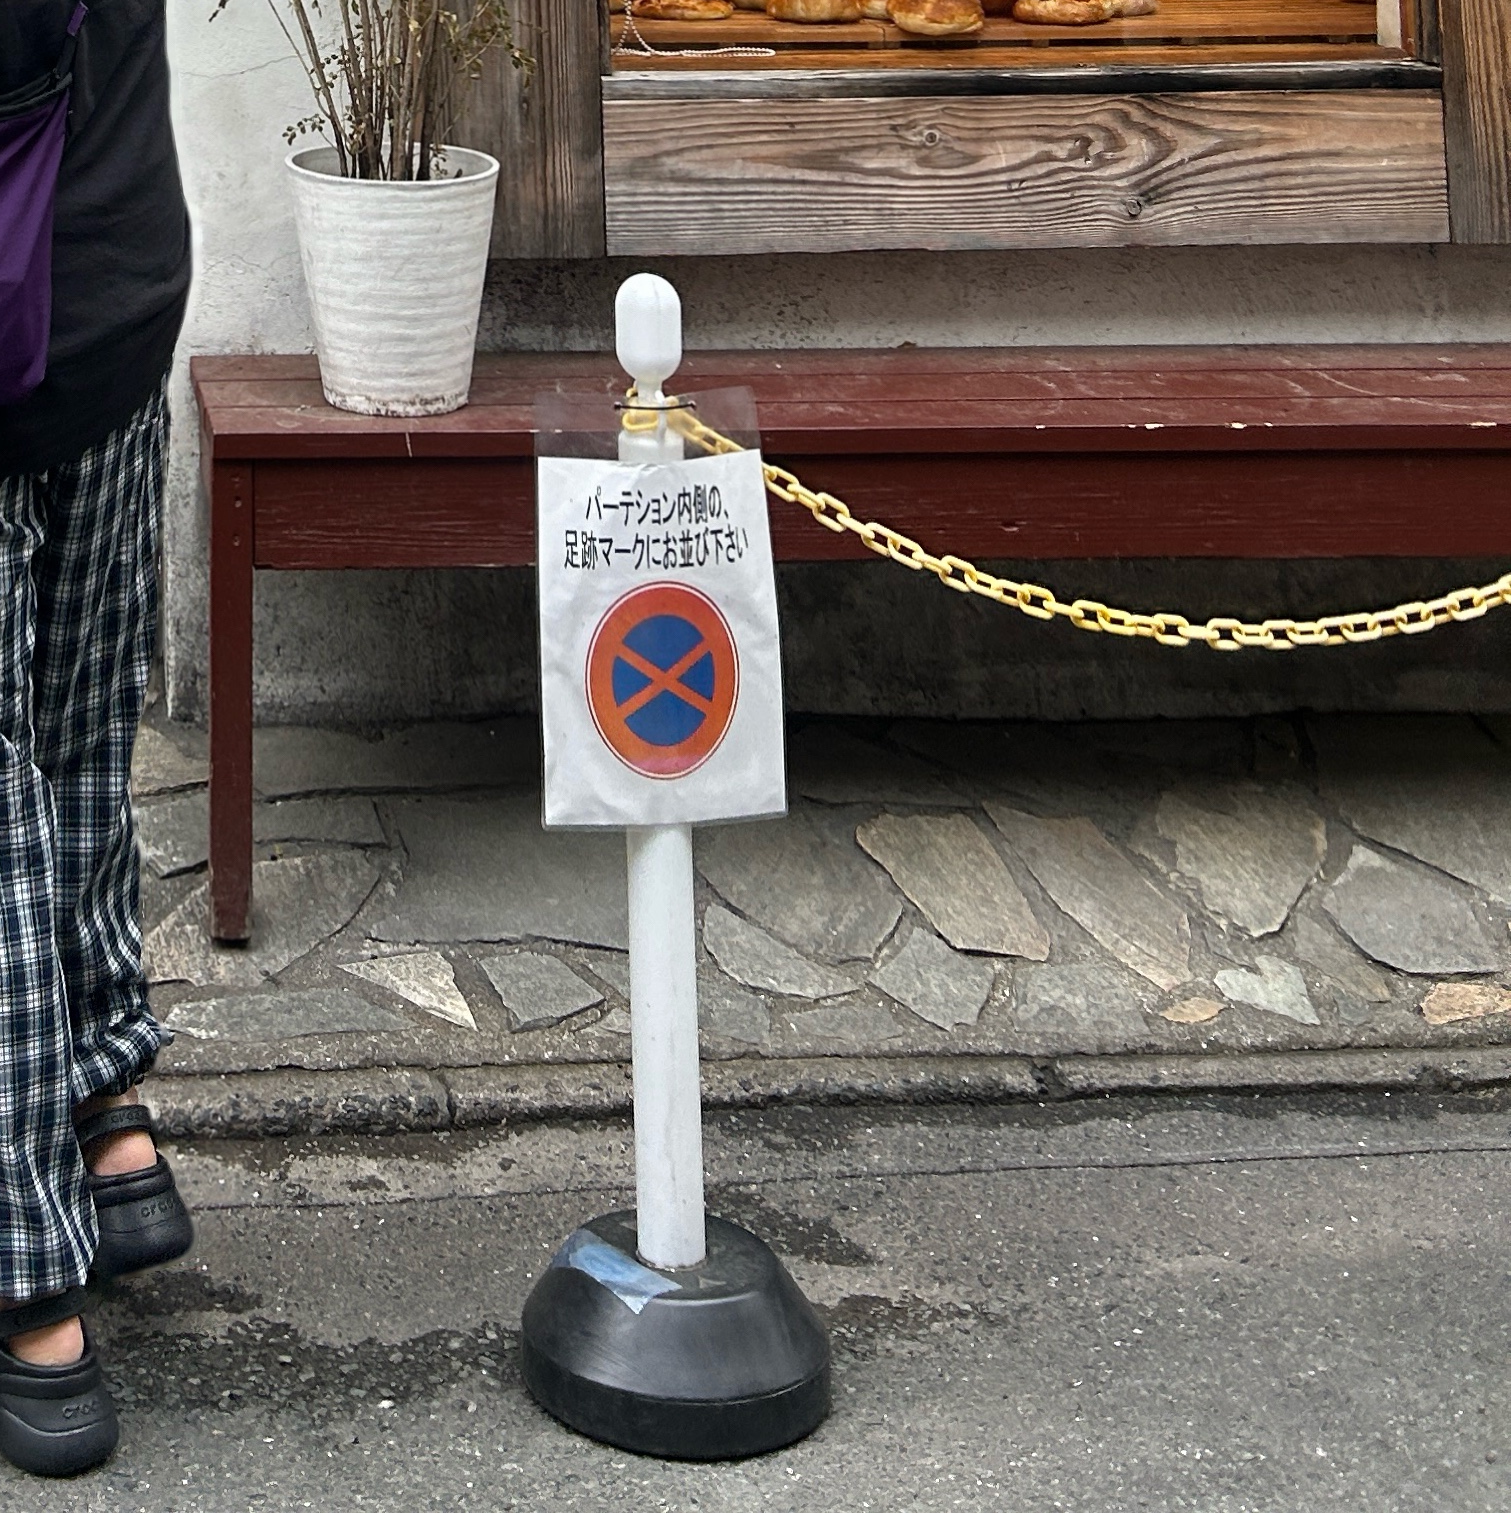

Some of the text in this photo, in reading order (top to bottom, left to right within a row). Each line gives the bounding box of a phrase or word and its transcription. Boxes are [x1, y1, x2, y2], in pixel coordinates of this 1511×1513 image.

[585, 484, 729, 526] パーテション内側の、
[564, 523, 748, 570] 足跡マークにお並び下さい
